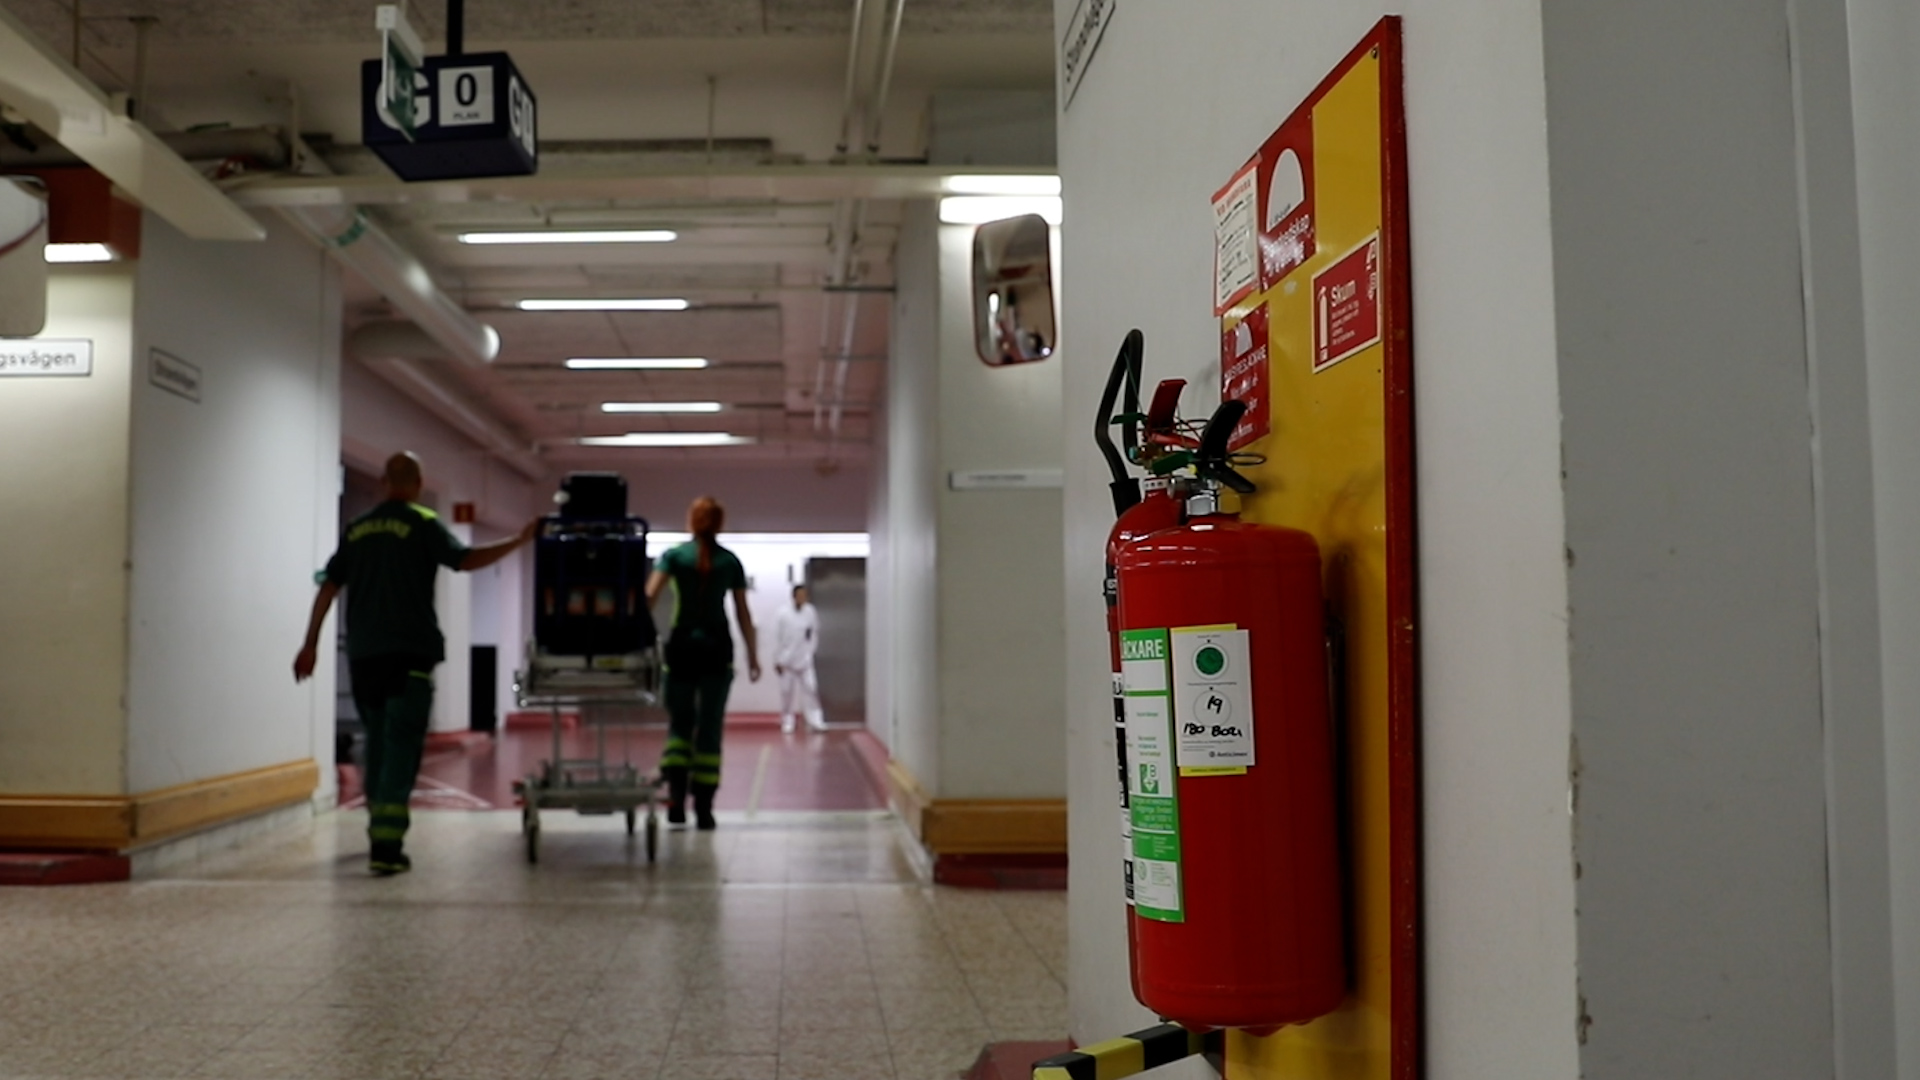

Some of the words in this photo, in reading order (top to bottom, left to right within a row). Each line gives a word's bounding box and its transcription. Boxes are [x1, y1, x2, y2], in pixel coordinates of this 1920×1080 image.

[455, 73, 477, 107] 0
[1331, 280, 1356, 307] Skum
[1207, 695, 1223, 714] 19
